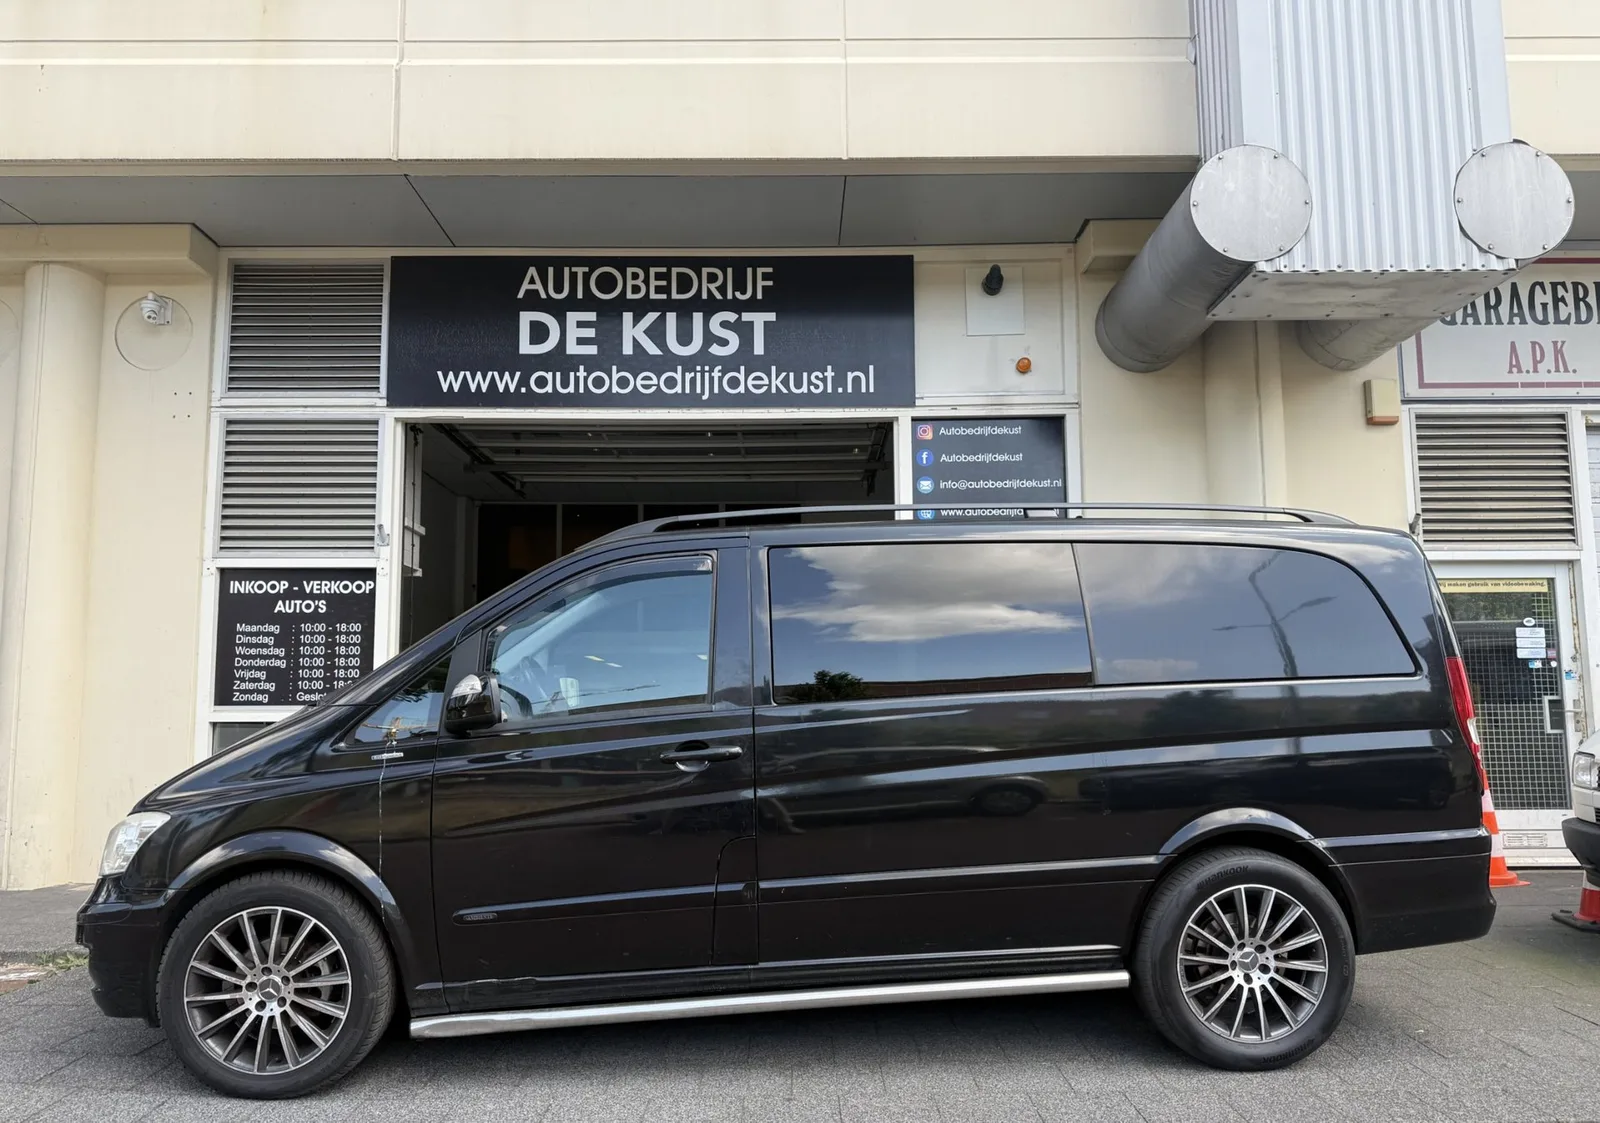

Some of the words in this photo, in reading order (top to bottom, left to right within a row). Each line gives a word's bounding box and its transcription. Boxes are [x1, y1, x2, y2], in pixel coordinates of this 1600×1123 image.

[517, 266, 774, 300] AUTOBEDRIJF
[1439, 281, 1600, 326] ARAGEB
[518, 311, 598, 355] DE
[621, 311, 777, 356] KUST
[1507, 340, 1578, 374] A.P.K.
[437, 365, 875, 400] www.autobedrijfdekust.nl
[939, 425, 1022, 437] Autobedrijfdekust
[940, 452, 1024, 464] Autobedrijfdekust
[940, 478, 1062, 490] info@autobedrijfdekust.nl
[229, 580, 289, 594] INKOOP
[303, 580, 375, 594] VERKOOP
[274, 600, 327, 614] AUTO'S
[236, 623, 280, 634] Maandag
[300, 623, 326, 632] 10:00
[335, 623, 362, 632] 18:00
[235, 634, 275, 646] Dinsdag
[300, 635, 326, 643] 10:00
[335, 634, 361, 644] 18:00
[235, 646, 285, 657] Woensdag
[299, 646, 325, 655] 10:00
[335, 646, 361, 655] 18:00
[235, 657, 287, 669] Donderdag
[299, 658, 325, 667] 10:00
[334, 658, 361, 667] 18:00
[234, 669, 267, 680] Vrijdag
[298, 669, 324, 678] 10:00
[333, 669, 360, 678] 18:00
[233, 680, 275, 692] Zaterdag
[297, 681, 323, 690] 10:00
[233, 692, 269, 703] Zondag
